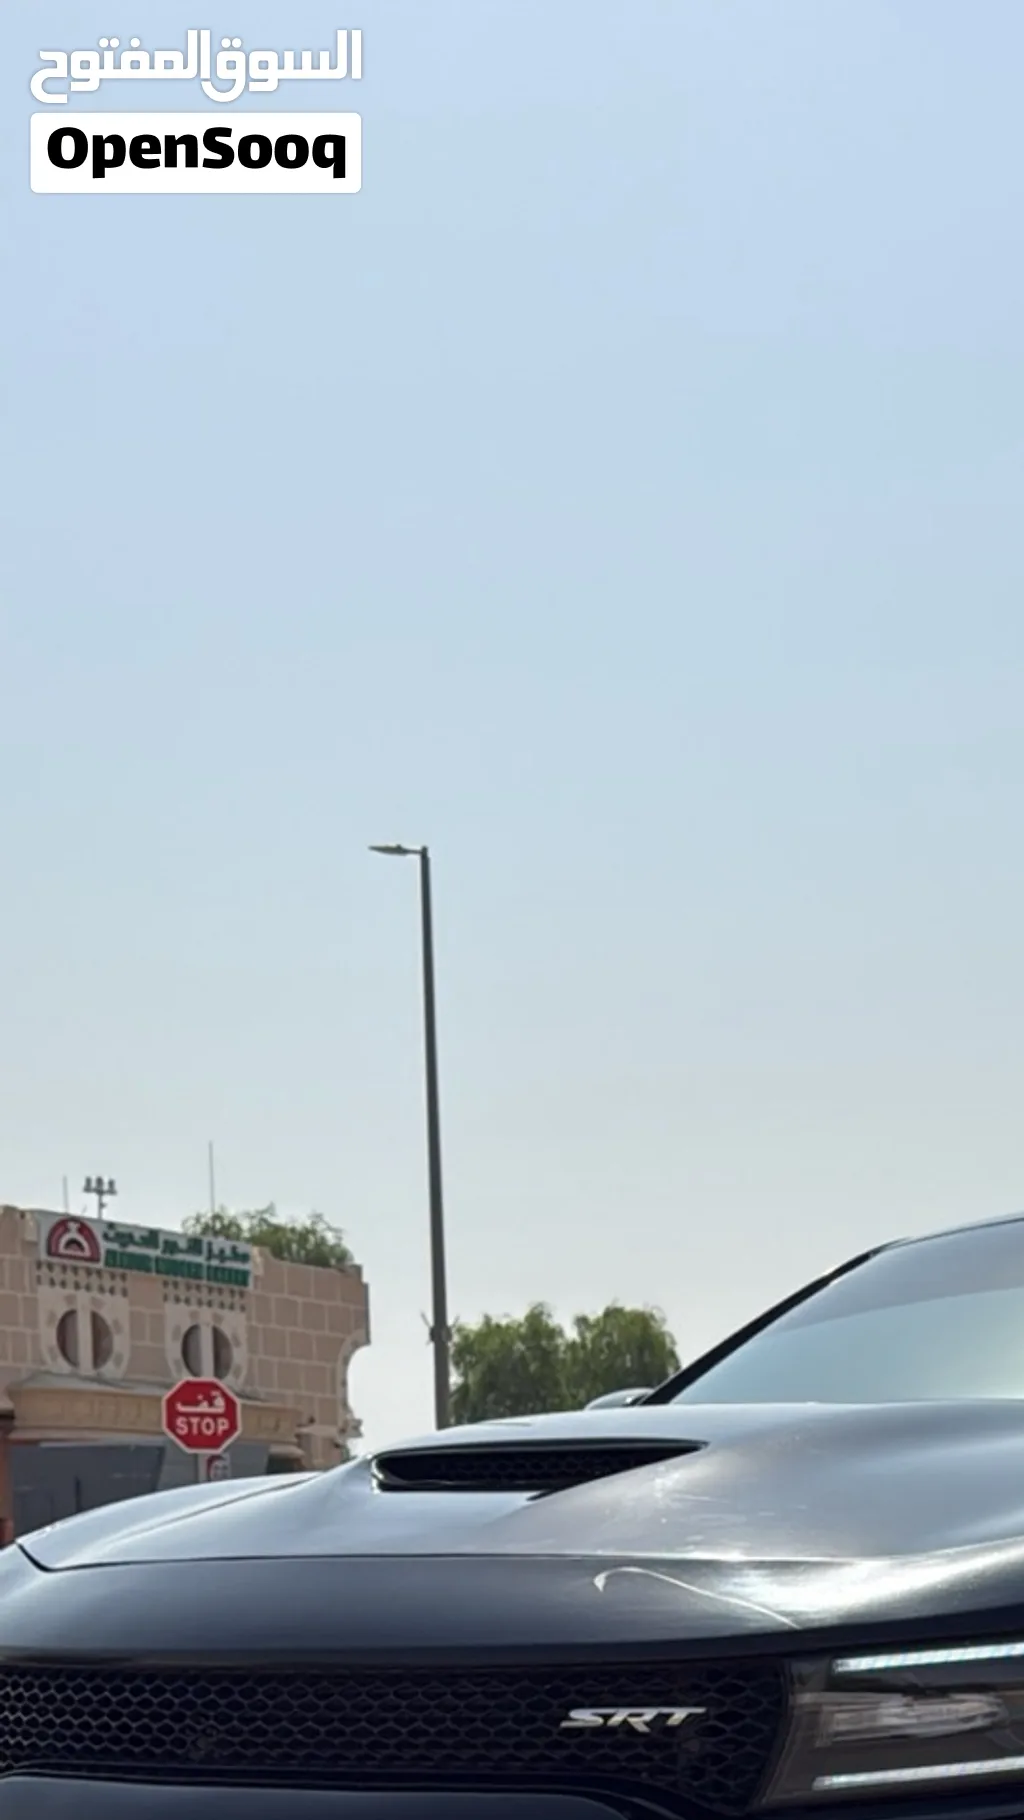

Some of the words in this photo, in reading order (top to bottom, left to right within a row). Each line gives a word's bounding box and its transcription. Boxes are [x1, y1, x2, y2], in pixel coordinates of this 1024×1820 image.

[175, 1390, 226, 1413] قف
[175, 1416, 230, 1436] STOP
[559, 1706, 708, 1733] SRT
